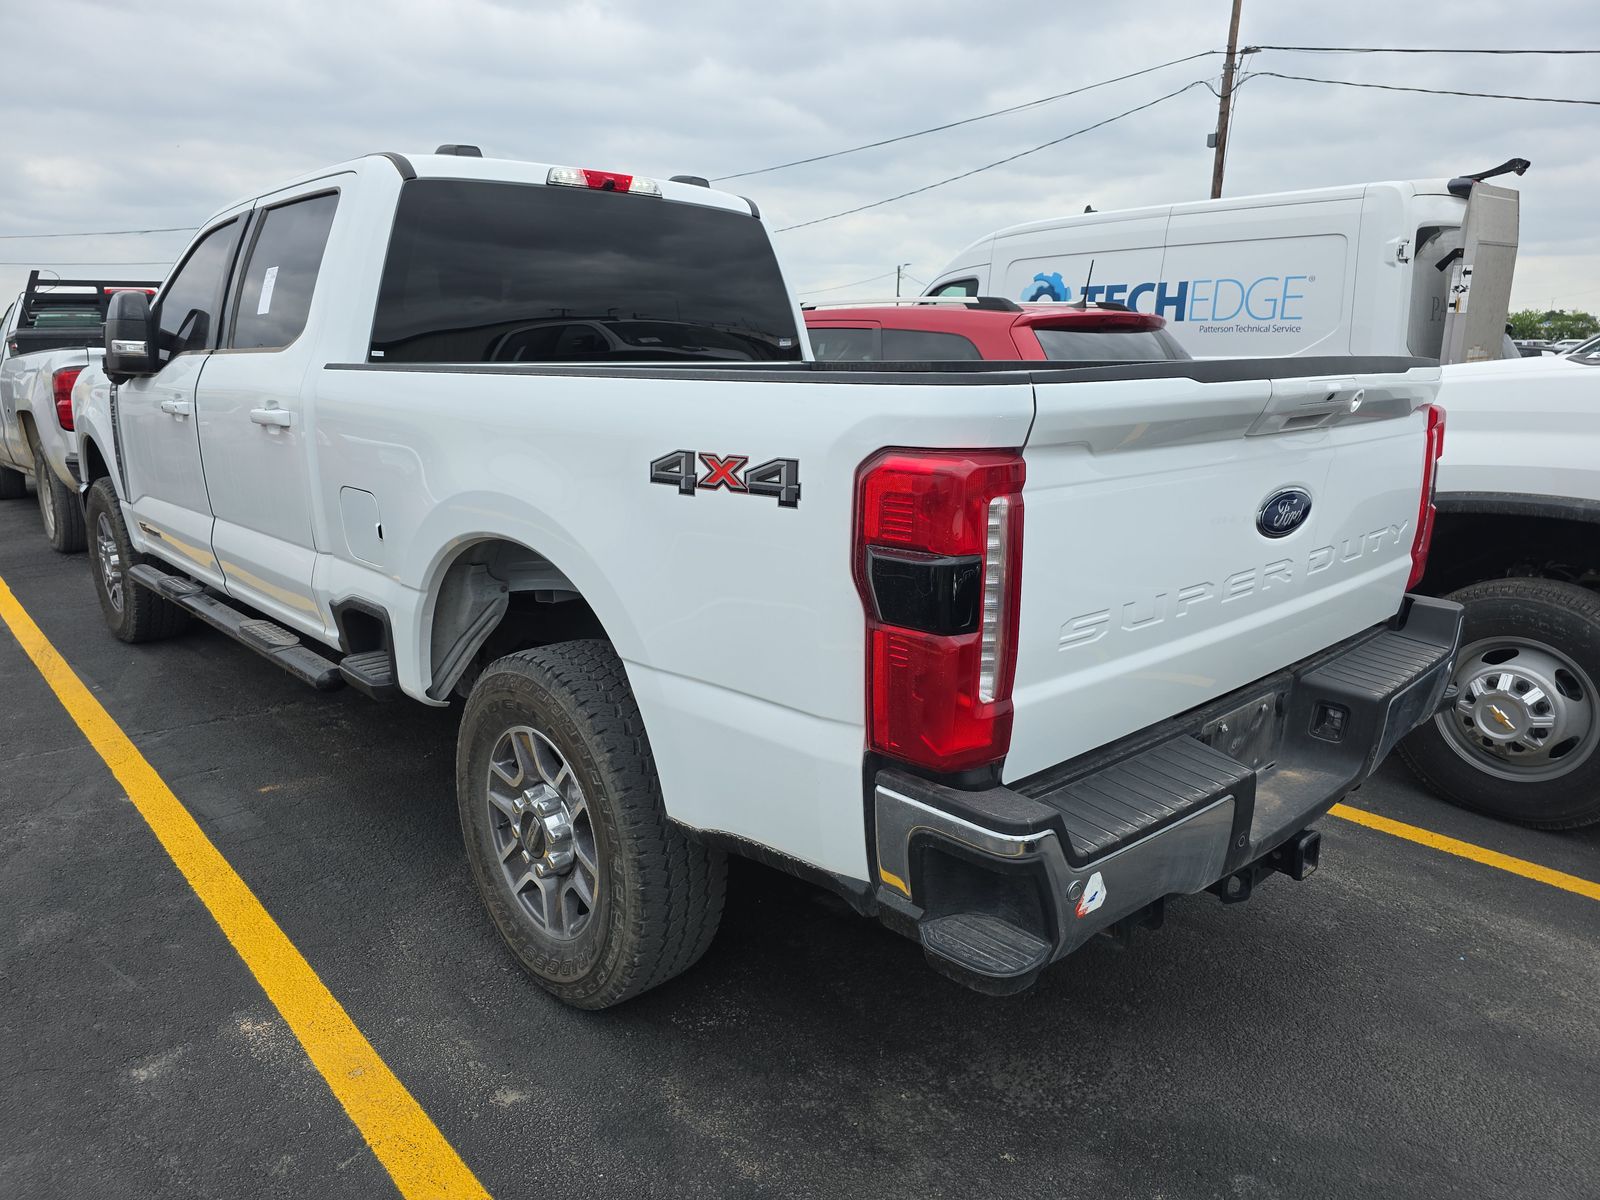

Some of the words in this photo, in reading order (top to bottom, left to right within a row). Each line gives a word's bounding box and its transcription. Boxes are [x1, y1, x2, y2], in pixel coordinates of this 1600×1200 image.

[1080, 275, 1308, 322] TECHEDGE
[1199, 324, 1234, 334] Patterson
[1235, 323, 1271, 333] Technical
[1271, 323, 1301, 333] Service
[1273, 498, 1305, 527] Ford
[1058, 557, 1294, 652] SUPER
[1307, 518, 1409, 576] DUTY
